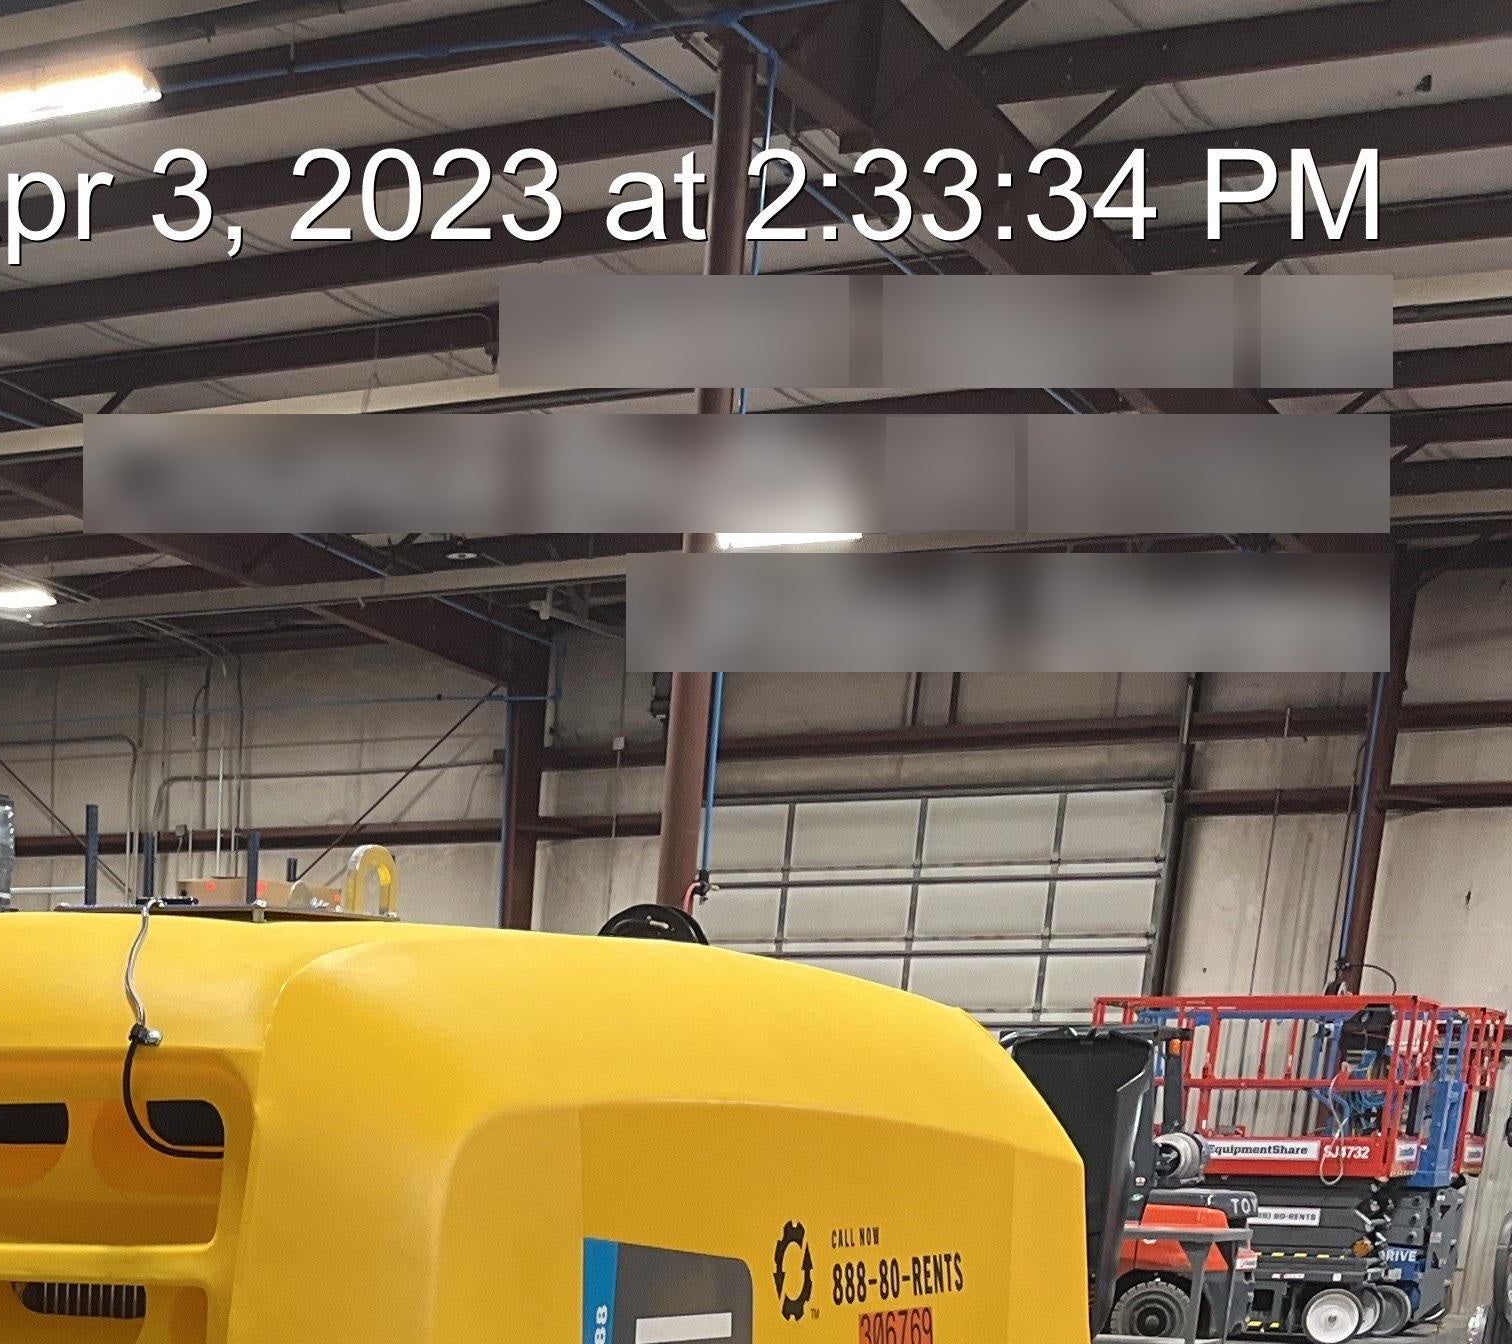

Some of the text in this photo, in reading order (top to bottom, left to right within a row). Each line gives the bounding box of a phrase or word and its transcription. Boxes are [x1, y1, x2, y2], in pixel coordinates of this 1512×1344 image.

[1207, 1144, 1308, 1155] EquipmentShare
[831, 1227, 879, 1249] CALL NOW
[1380, 1249, 1417, 1262] RIVE
[833, 1252, 964, 1305] 888-80-RENTS
